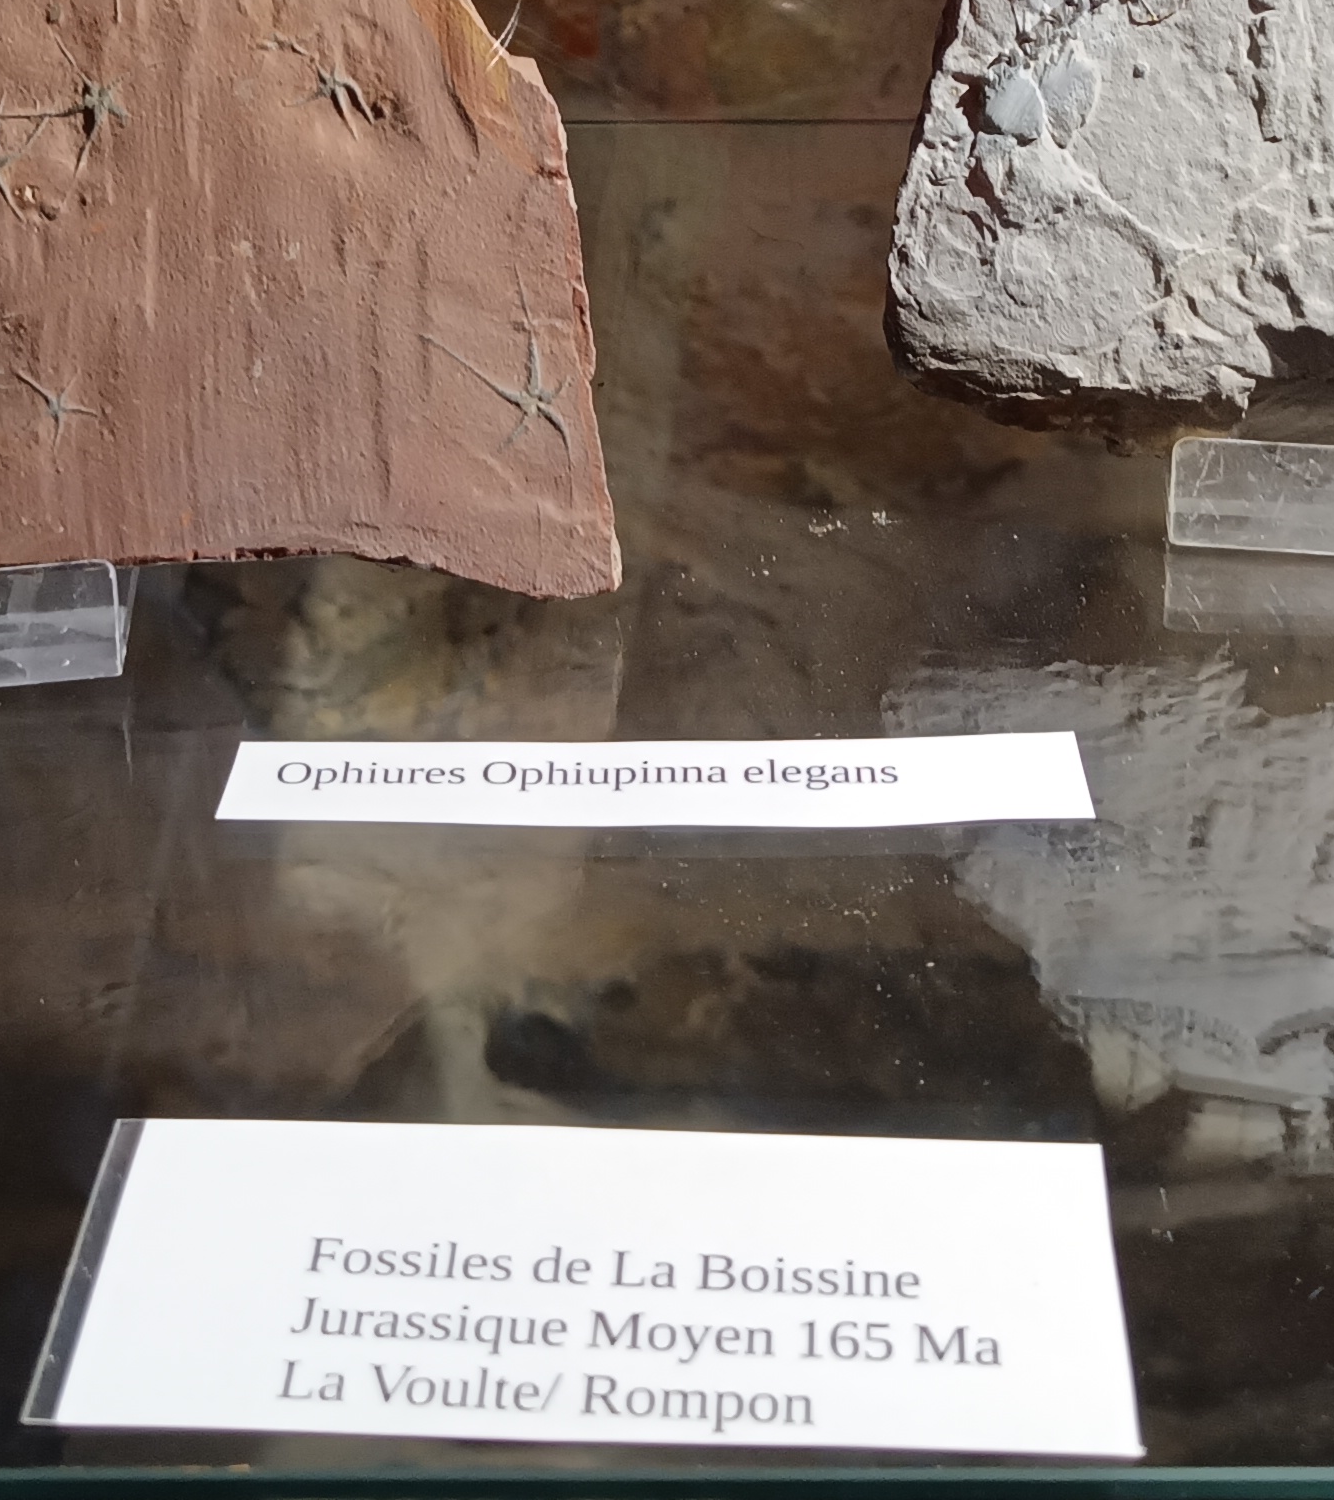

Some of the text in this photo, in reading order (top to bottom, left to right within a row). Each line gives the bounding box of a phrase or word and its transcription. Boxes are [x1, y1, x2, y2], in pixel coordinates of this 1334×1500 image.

[276, 758, 900, 792] Ophiures Ophiupinna elegans
[307, 1236, 922, 1299] Fossiles de La Boissine
[289, 1297, 1002, 1367] Jurassique Moyen 165 Ma
[278, 1359, 814, 1432] La Voulte/ Rompon
